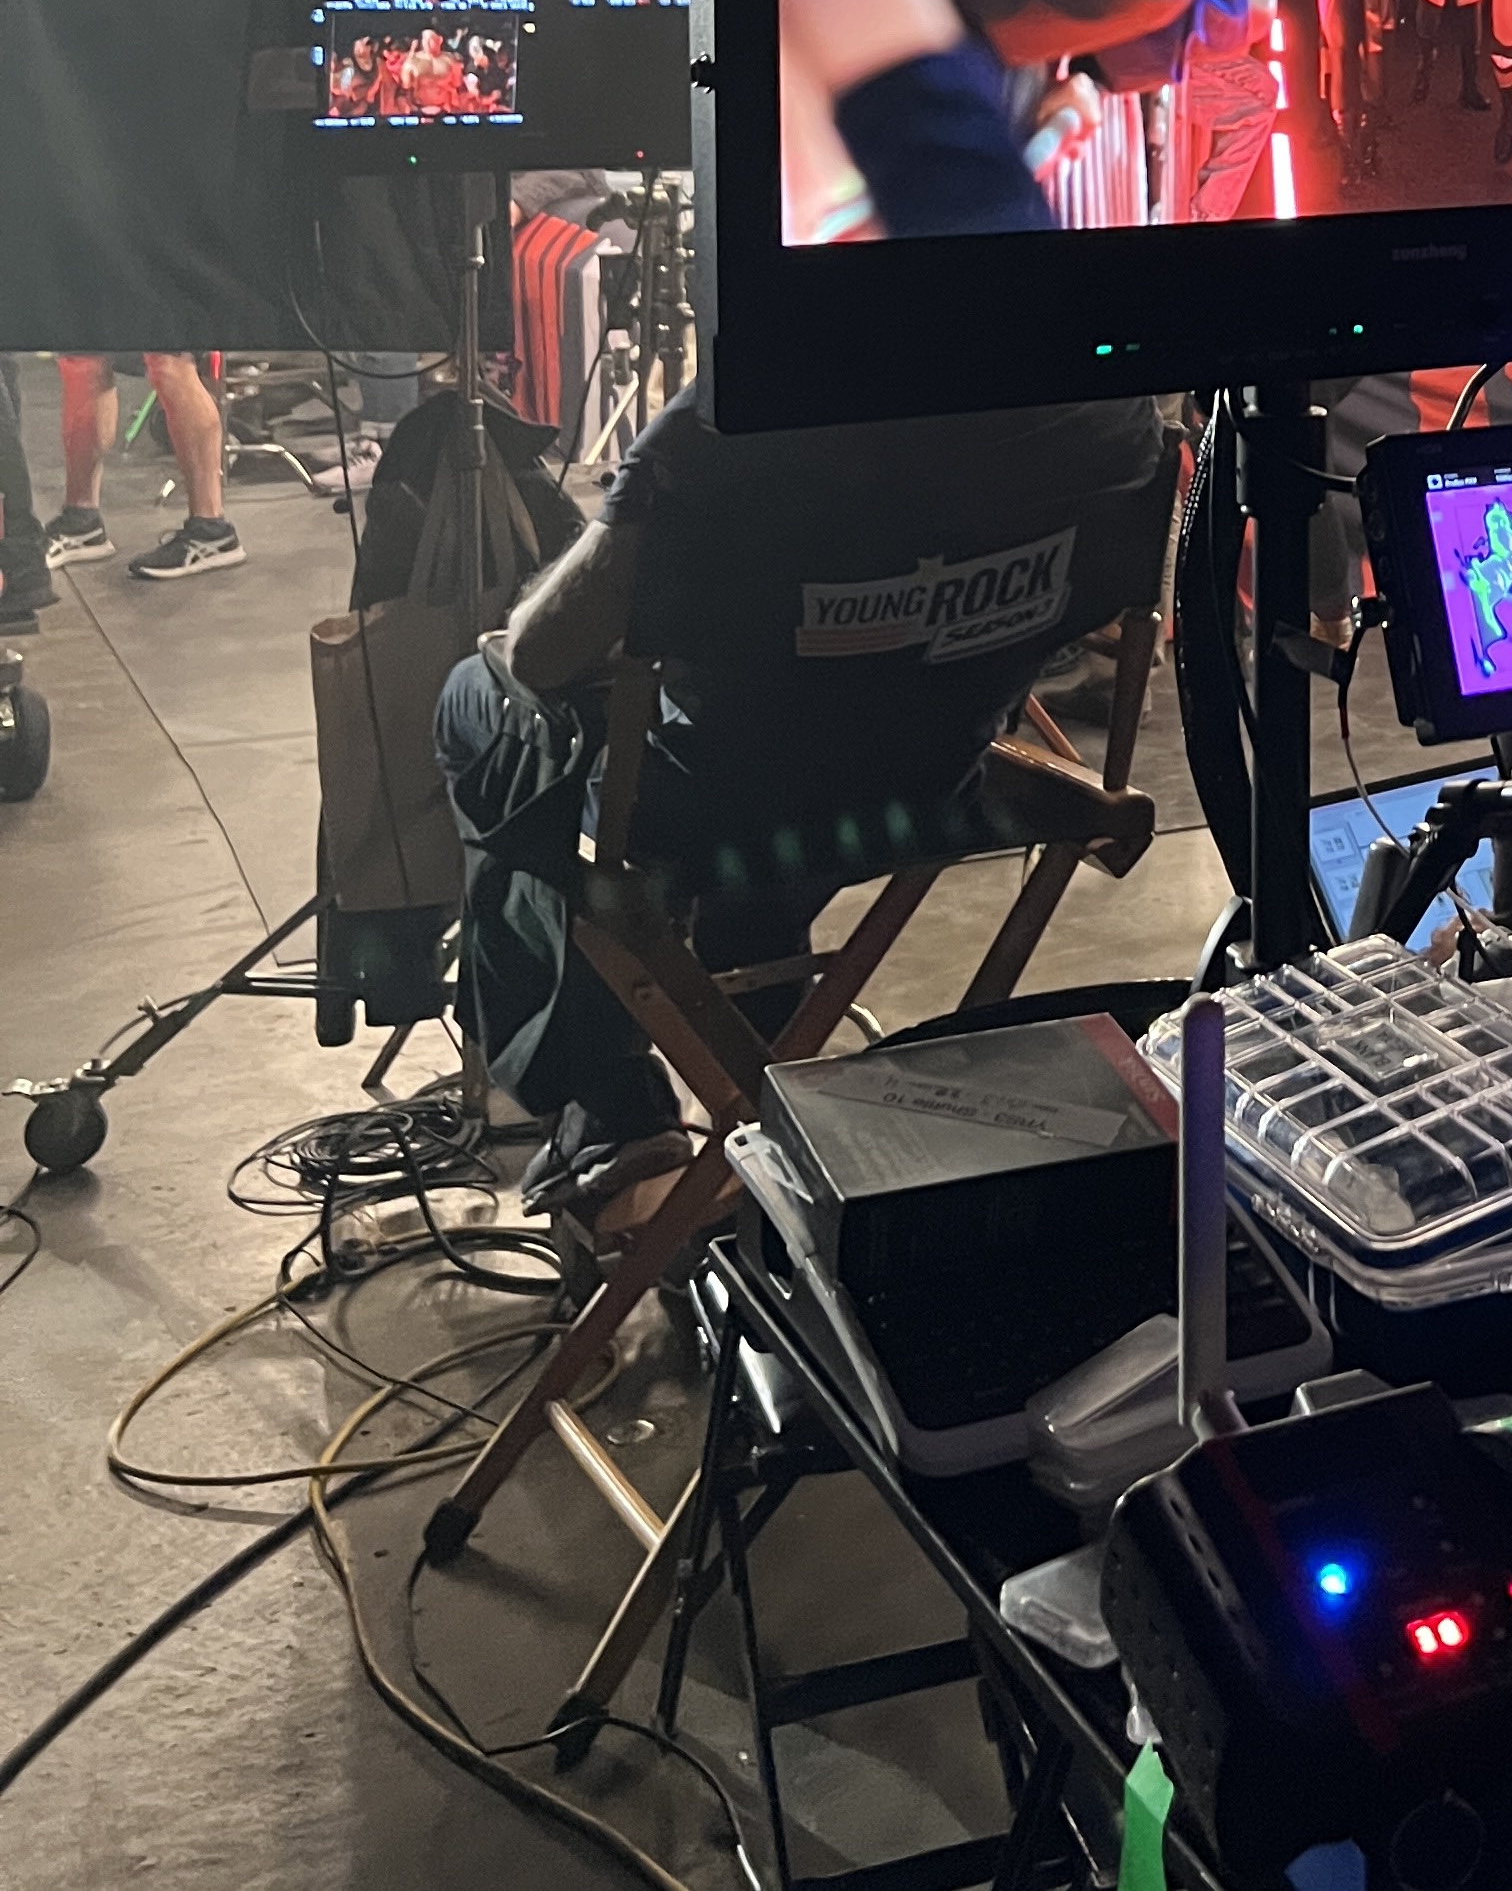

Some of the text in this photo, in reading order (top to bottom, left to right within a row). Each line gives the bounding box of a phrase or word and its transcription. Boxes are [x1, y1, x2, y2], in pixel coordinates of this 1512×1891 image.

[815, 543, 1063, 626] YOUNG ROCK
[945, 607, 1035, 642] SEASON
